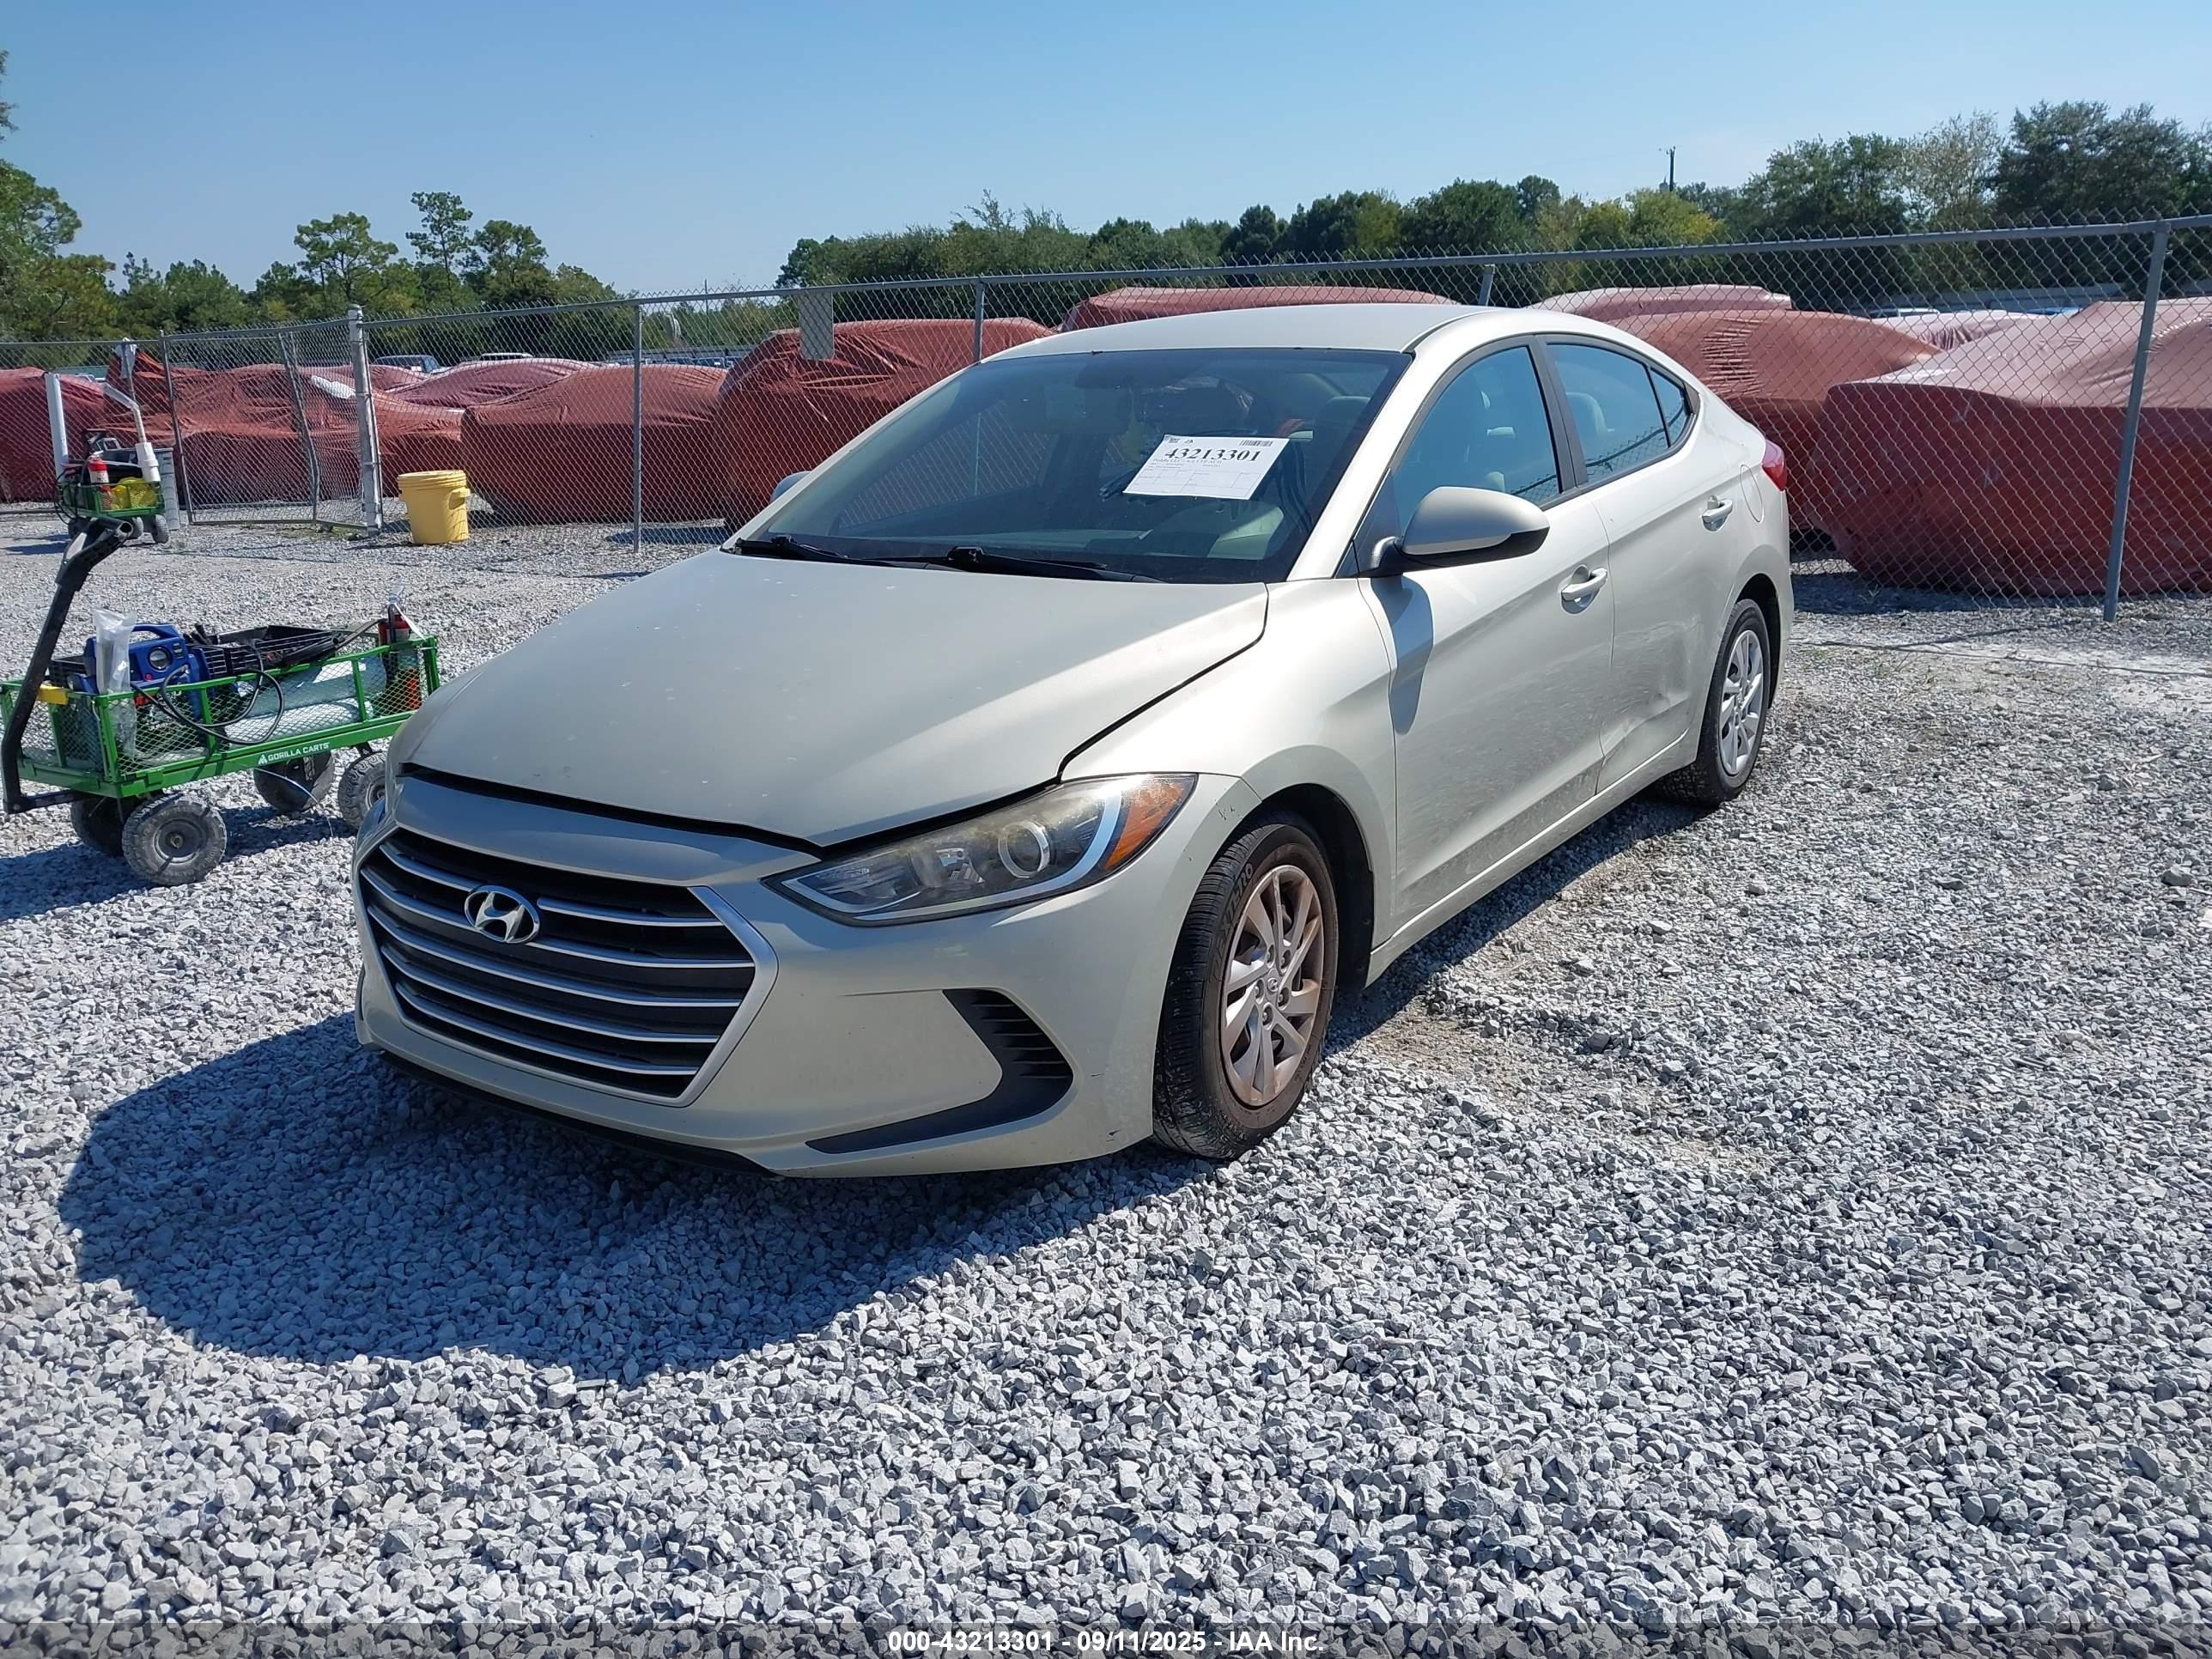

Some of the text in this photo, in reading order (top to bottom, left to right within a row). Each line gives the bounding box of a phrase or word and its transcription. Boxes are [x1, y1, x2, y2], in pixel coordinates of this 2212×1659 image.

[1164, 447, 1261, 462] 43213301
[268, 743, 329, 762] GORILLA CARTS
